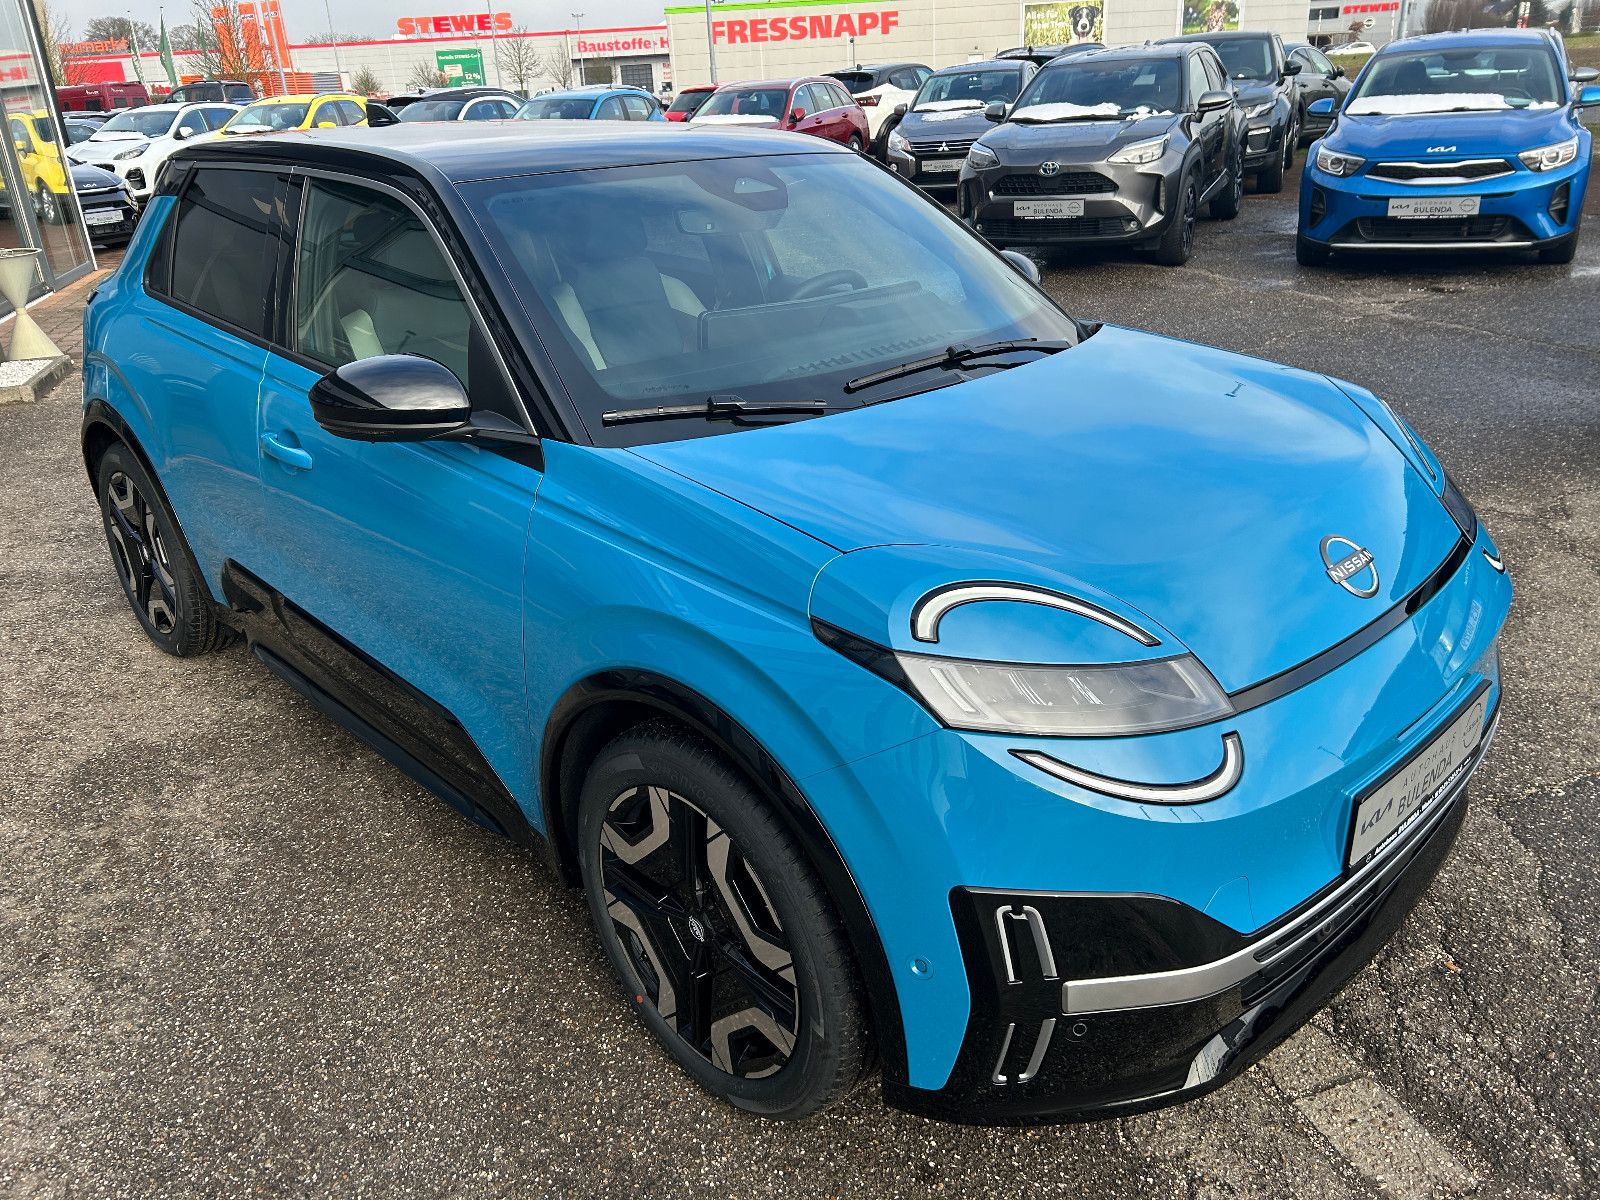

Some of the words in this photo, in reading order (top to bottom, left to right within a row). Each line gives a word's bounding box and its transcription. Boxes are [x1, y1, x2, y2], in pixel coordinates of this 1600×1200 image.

[1343, 2, 1399, 14] STEWES
[396, 11, 513, 35] STEWES
[711, 11, 899, 45] FRESSNAPF
[577, 38, 652, 53] Baustoffe
[1413, 206, 1453, 214] BULENDA
[1330, 550, 1373, 580] NISSAN
[1396, 751, 1453, 818] BULENDA
